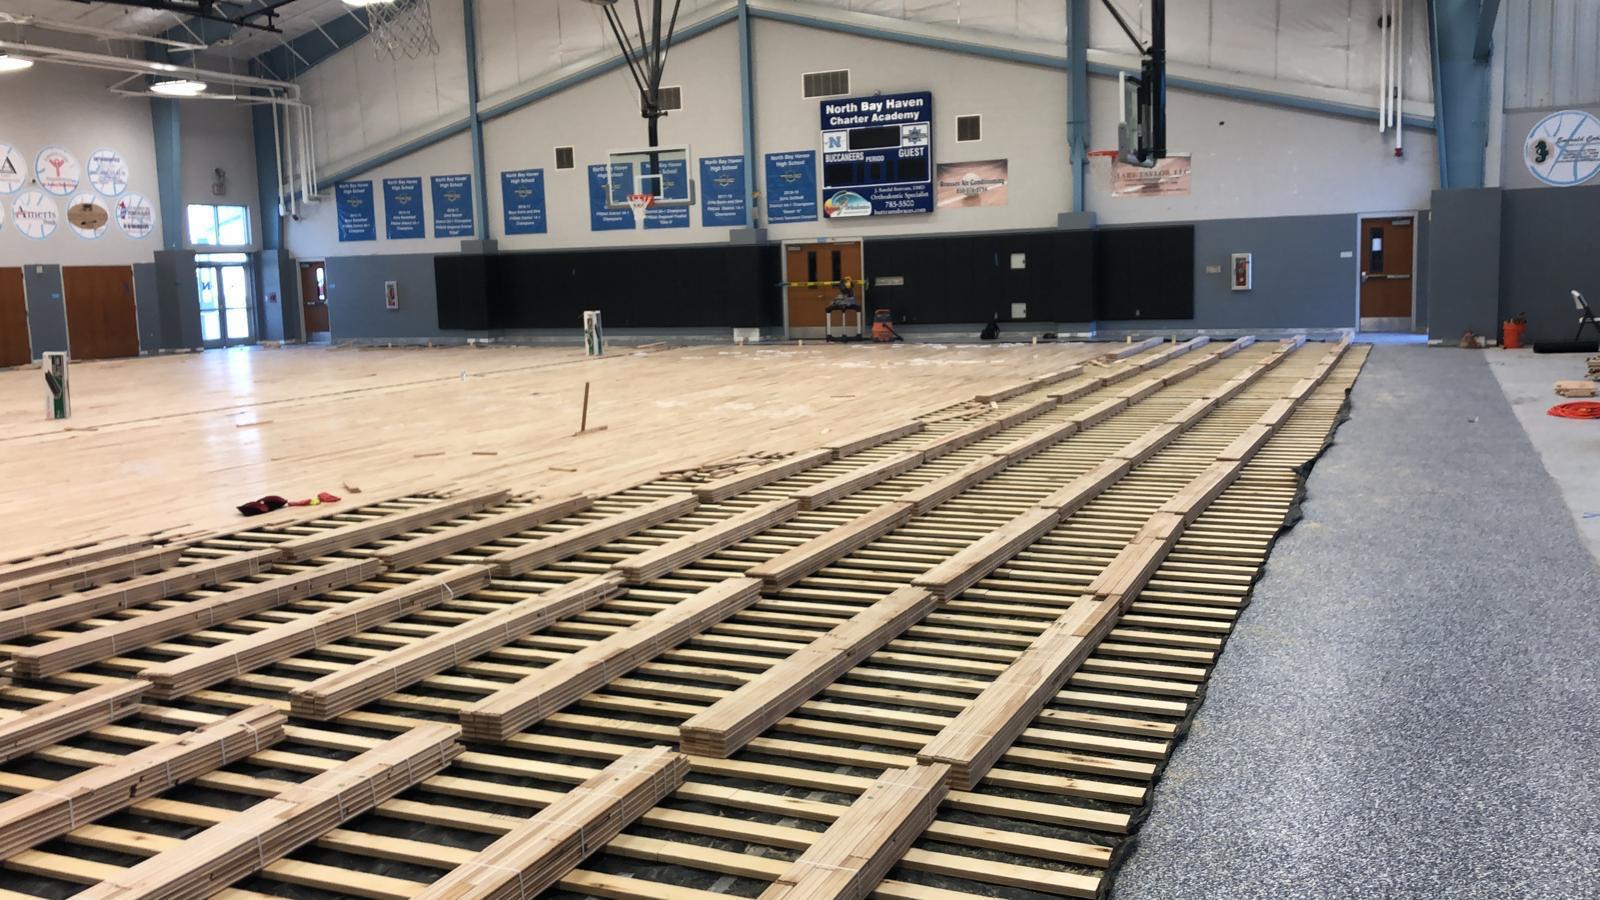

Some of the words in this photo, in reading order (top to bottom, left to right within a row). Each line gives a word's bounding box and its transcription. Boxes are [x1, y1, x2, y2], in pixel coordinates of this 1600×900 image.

[826, 104, 858, 114] North
[861, 101, 882, 112] Bay
[886, 98, 924, 109] Haven
[830, 115, 868, 126] Charter
[872, 110, 920, 122] Academy
[825, 152, 864, 162] BUCCANEERS
[898, 147, 924, 158] GUEST
[885, 200, 914, 208] 785-5500
